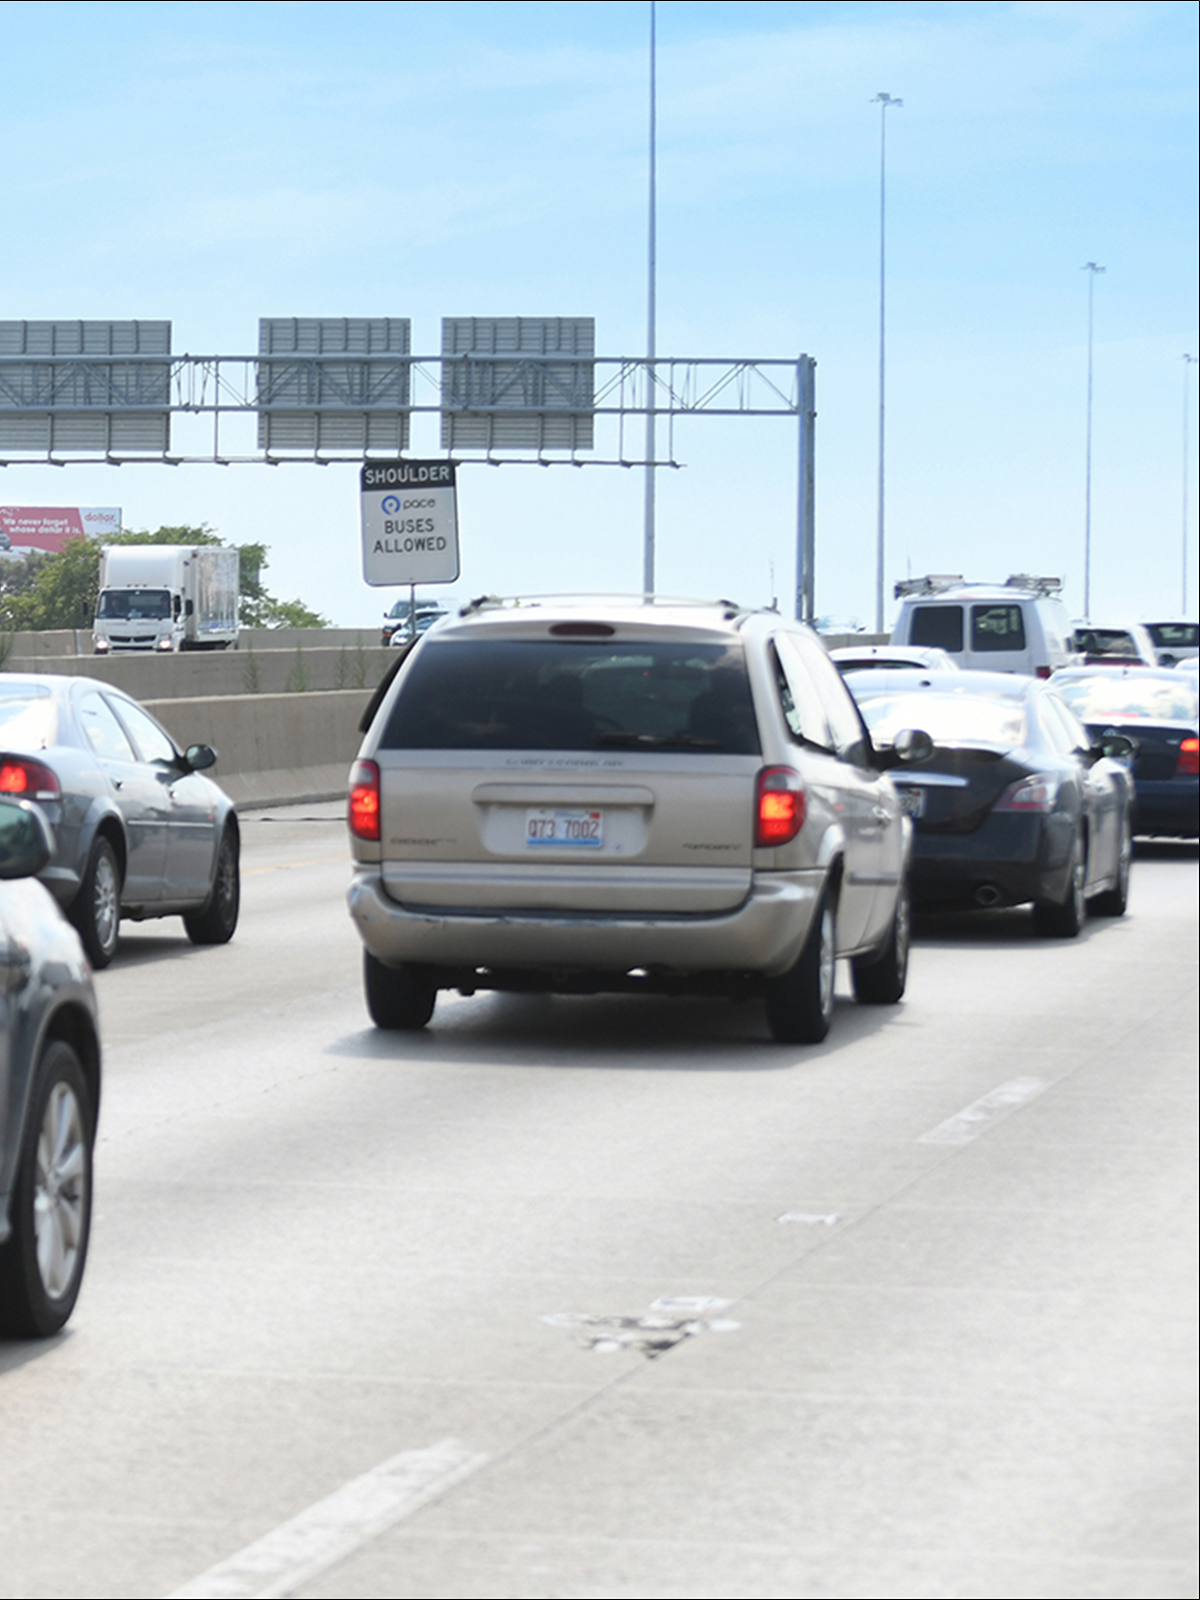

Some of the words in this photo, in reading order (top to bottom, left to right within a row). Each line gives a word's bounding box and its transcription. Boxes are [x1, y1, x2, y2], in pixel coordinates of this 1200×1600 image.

[365, 466, 449, 484] SHOULDER
[403, 499, 436, 510] pace
[3, 518, 16, 526] We
[18, 518, 41, 526] never
[43, 518, 68, 528] forget
[9, 526, 36, 534] whose
[38, 525, 63, 534] dollar
[385, 519, 434, 534] BUSES
[373, 537, 446, 553] ALLOWED
[529, 819, 556, 838] Q73
[564, 819, 599, 839] 7002
